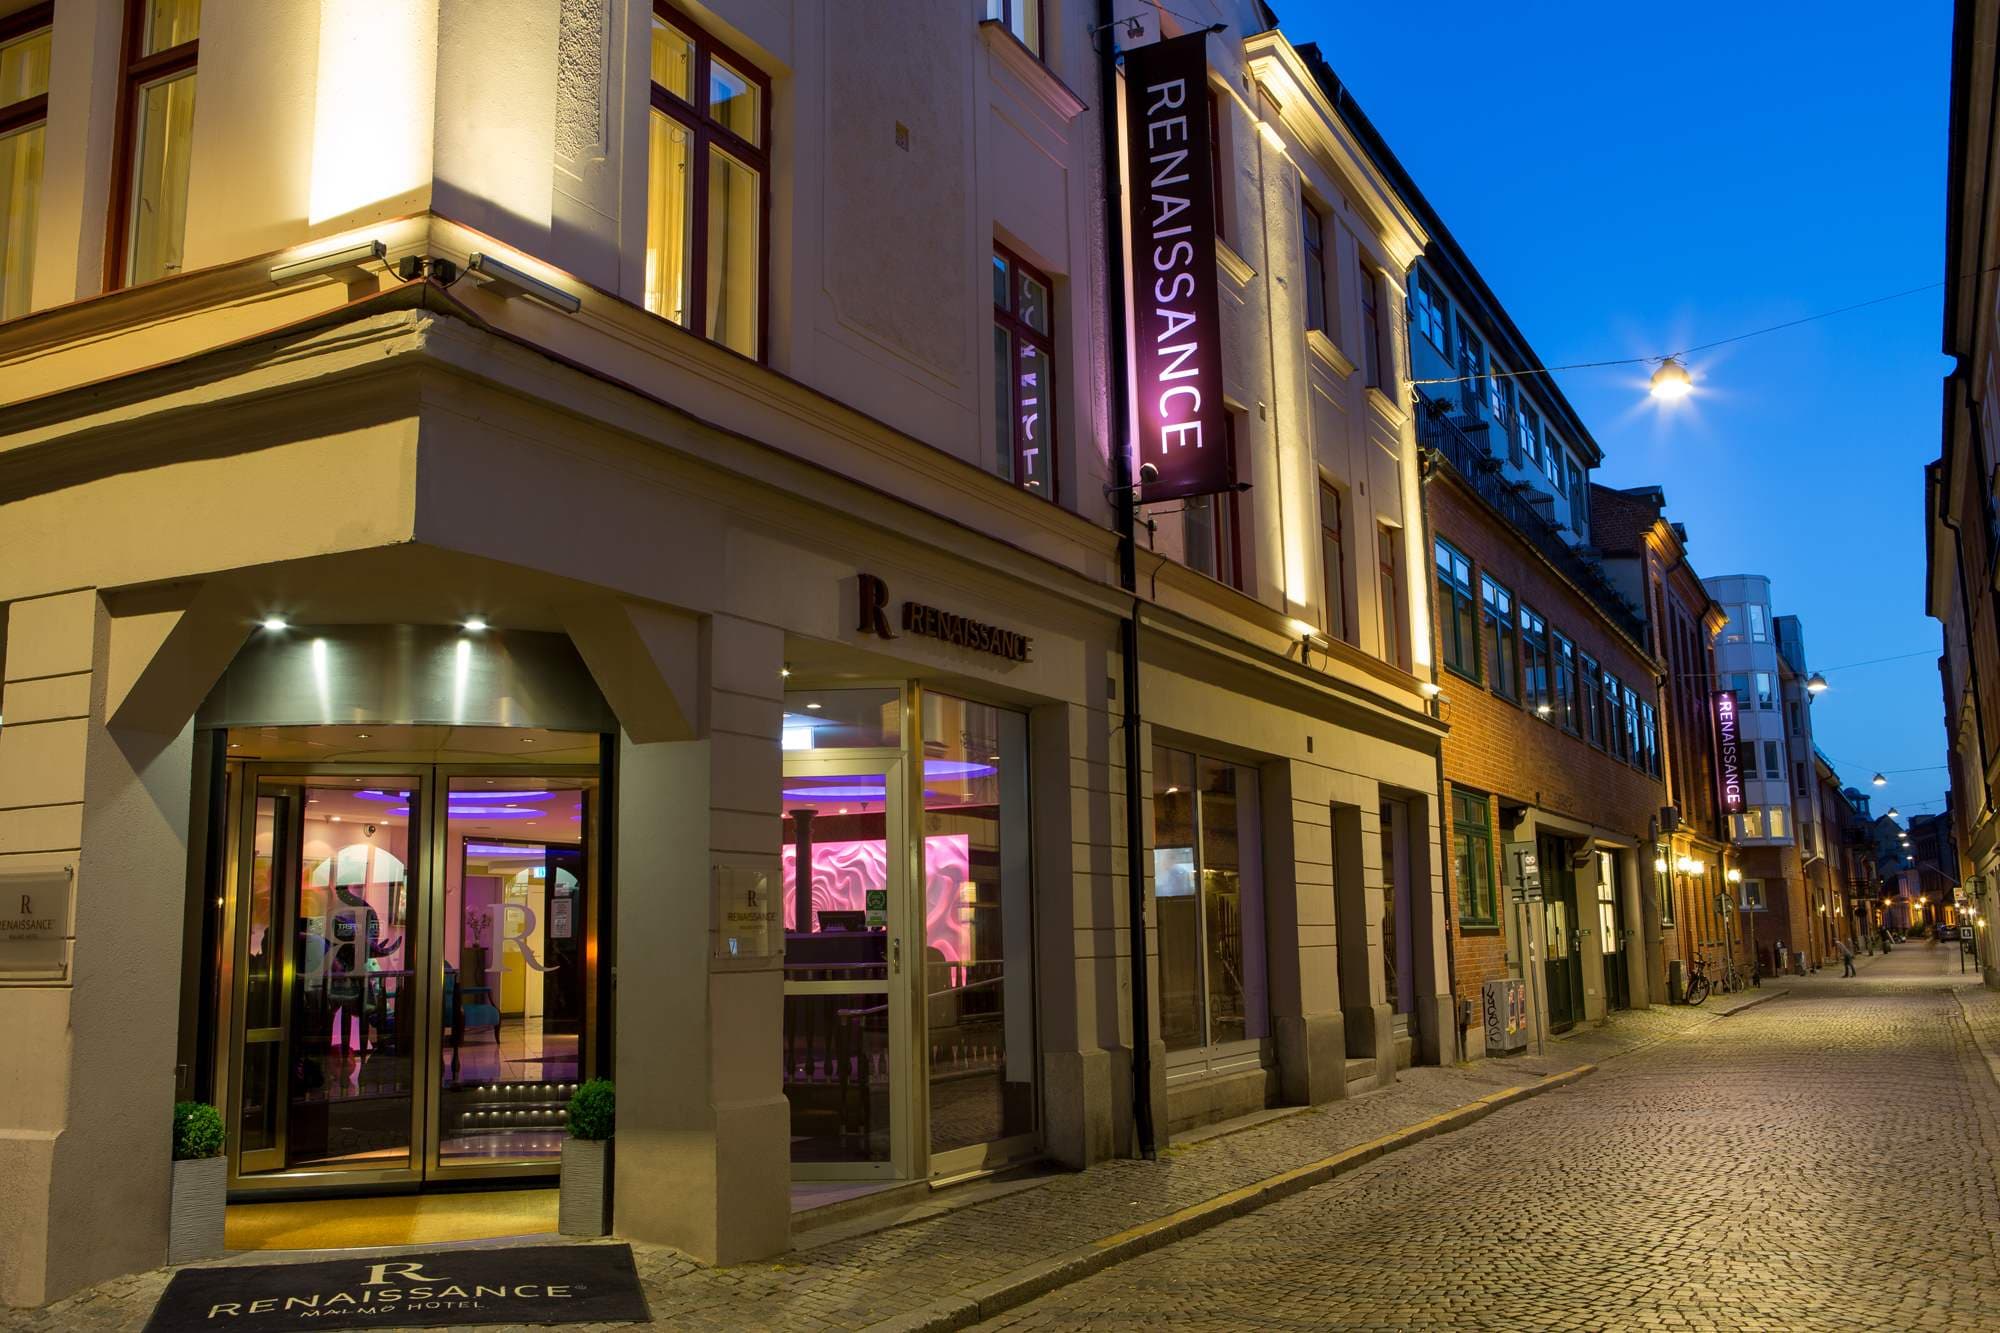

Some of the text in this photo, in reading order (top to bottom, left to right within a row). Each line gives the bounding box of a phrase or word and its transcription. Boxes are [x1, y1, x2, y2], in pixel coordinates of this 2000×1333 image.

[1147, 78, 1203, 455] RENAISSANCE
[857, 573, 1034, 663] R RENAISSANCE
[1719, 701, 1741, 803] RENAISSANCE
[20, 895, 32, 914] R
[748, 890, 758, 907] R
[484, 903, 560, 972] R
[361, 1262, 451, 1286] R
[207, 1285, 573, 1319] RENAISSANCE
[408, 1300, 485, 1312] HOTEL
